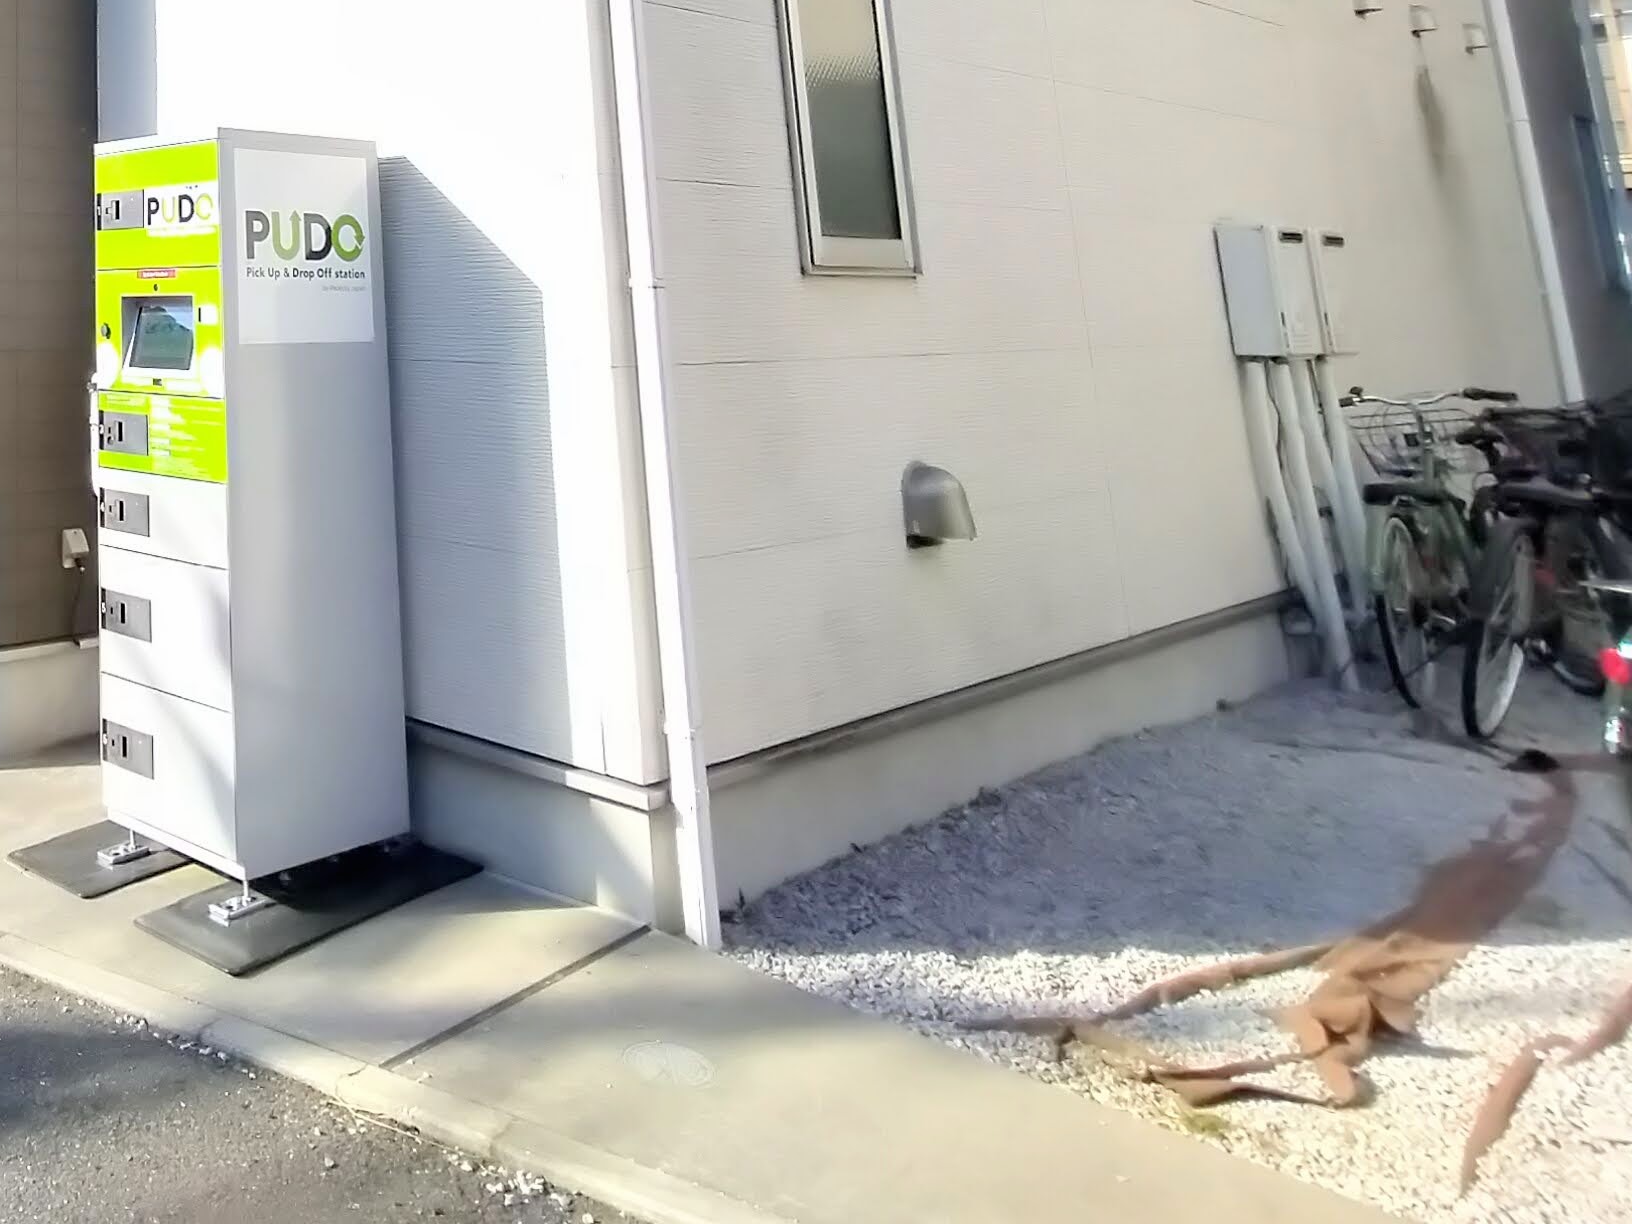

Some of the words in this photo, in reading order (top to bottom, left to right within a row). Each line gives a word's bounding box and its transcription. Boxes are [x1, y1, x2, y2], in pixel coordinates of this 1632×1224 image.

[147, 193, 214, 226] PUDO
[245, 209, 366, 262] PUDO
[246, 267, 266, 278] Pick
[267, 267, 281, 281] Up
[283, 267, 290, 278] &
[292, 267, 315, 281] Drop
[317, 268, 333, 279] Off
[334, 268, 366, 279] station
